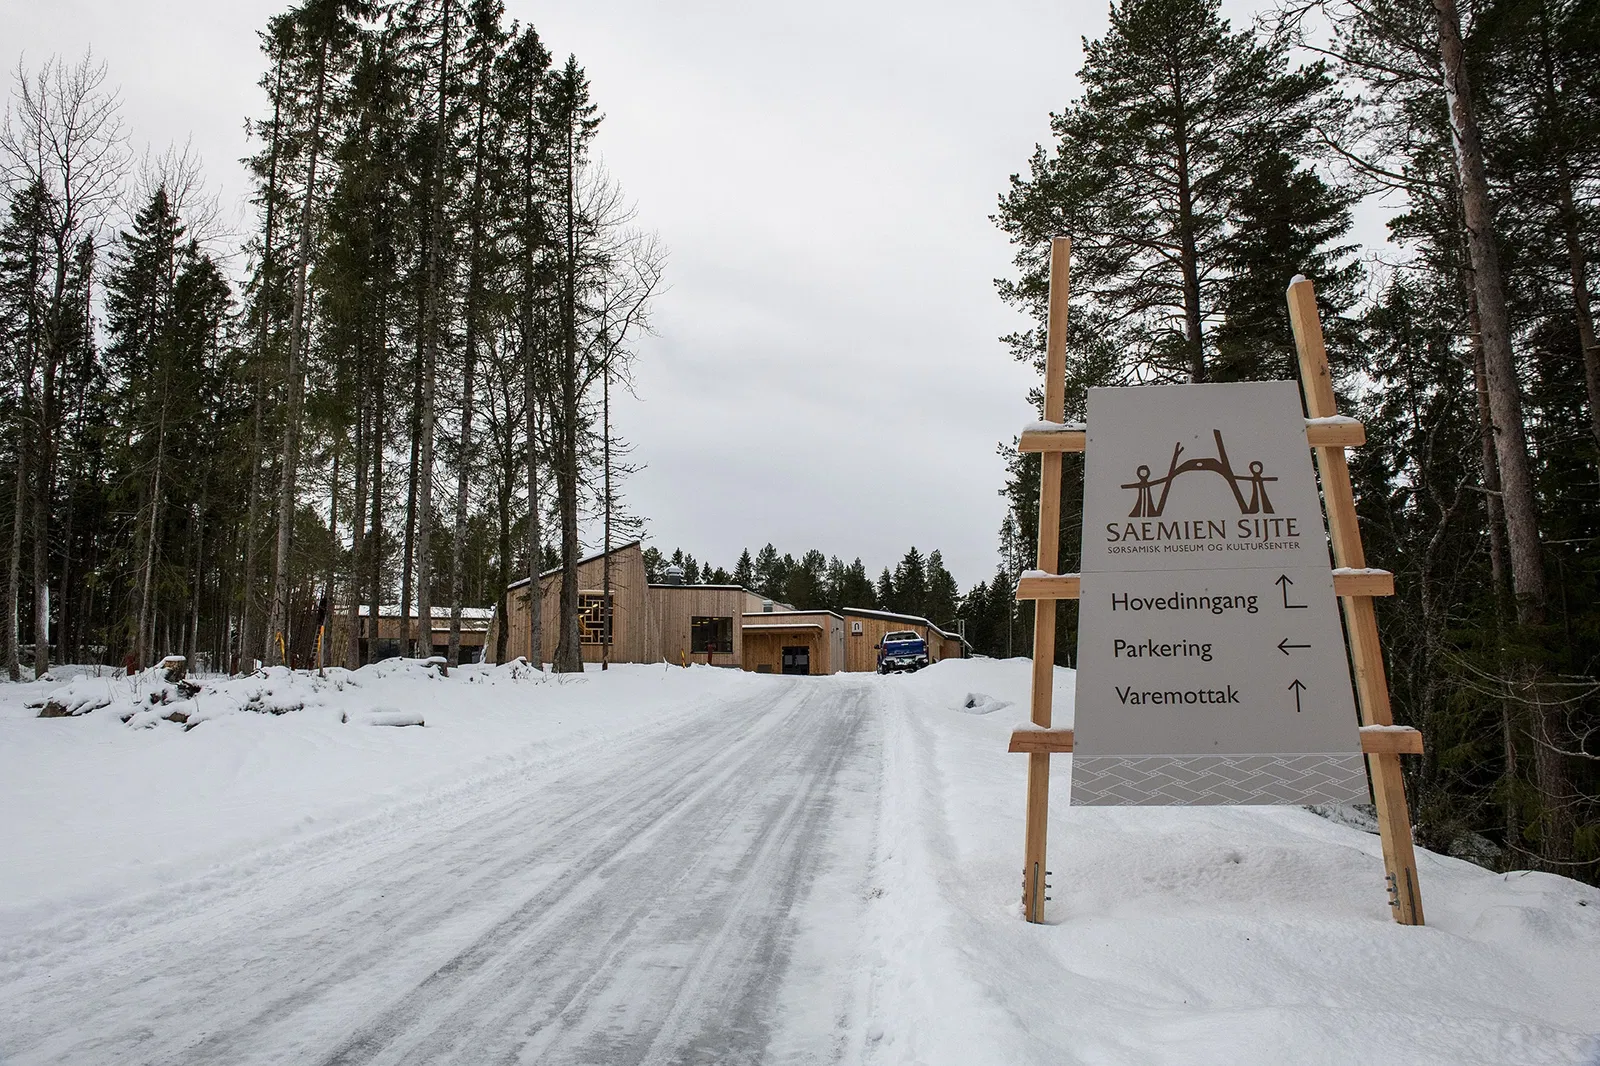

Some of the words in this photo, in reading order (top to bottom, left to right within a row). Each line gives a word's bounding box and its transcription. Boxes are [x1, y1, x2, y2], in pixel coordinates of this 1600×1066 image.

[1106, 520, 1226, 541] SAEMIEN
[1237, 518, 1300, 542] SIJTE
[1107, 544, 1161, 554] SØRSAMISK
[1164, 543, 1204, 553] MUSEUM
[1207, 542, 1223, 552] OG
[1226, 541, 1301, 551] KULTURSENTER
[1112, 592, 1259, 614] Hovedinngang
[1114, 639, 1213, 662] Parkering
[1115, 685, 1240, 705] Varemottak
